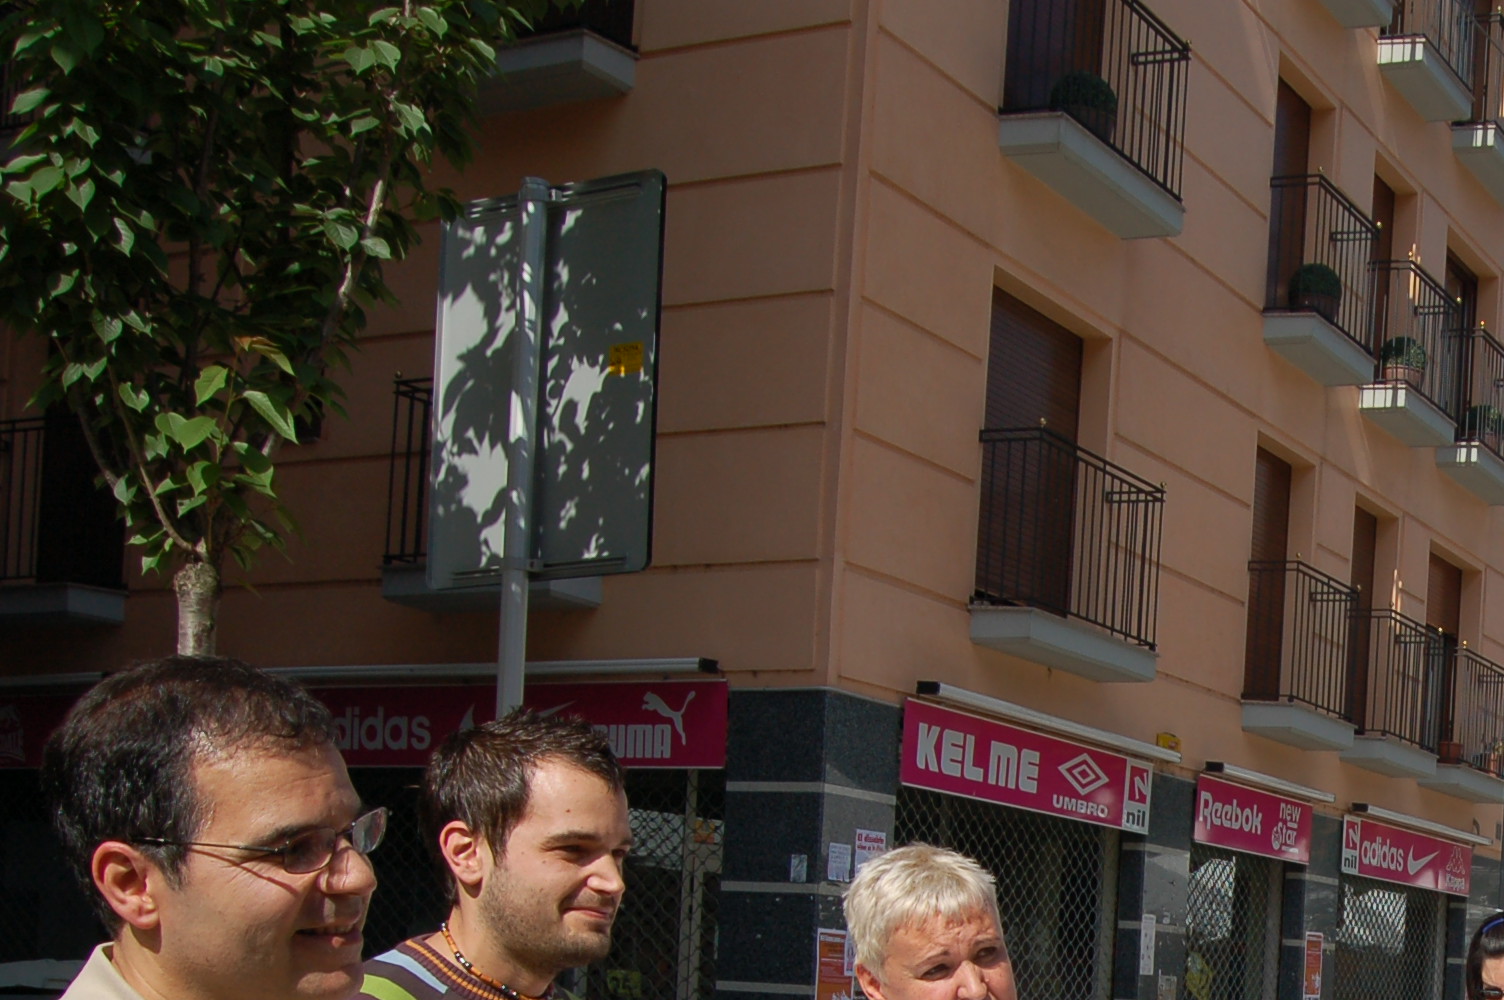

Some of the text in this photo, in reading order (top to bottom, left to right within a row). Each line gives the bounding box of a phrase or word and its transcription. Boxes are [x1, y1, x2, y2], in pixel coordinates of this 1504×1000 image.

[335, 713, 432, 751] didas
[595, 723, 672, 759] UMA
[916, 722, 1040, 794] KELME
[1052, 794, 1108, 818] UMBRO
[1126, 808, 1146, 828] nil
[1199, 790, 1262, 835] Reebok
[1280, 802, 1301, 823] new
[1343, 855, 1357, 869] nil
[1361, 837, 1404, 872] adidas
[1445, 873, 1465, 891] Kappa
